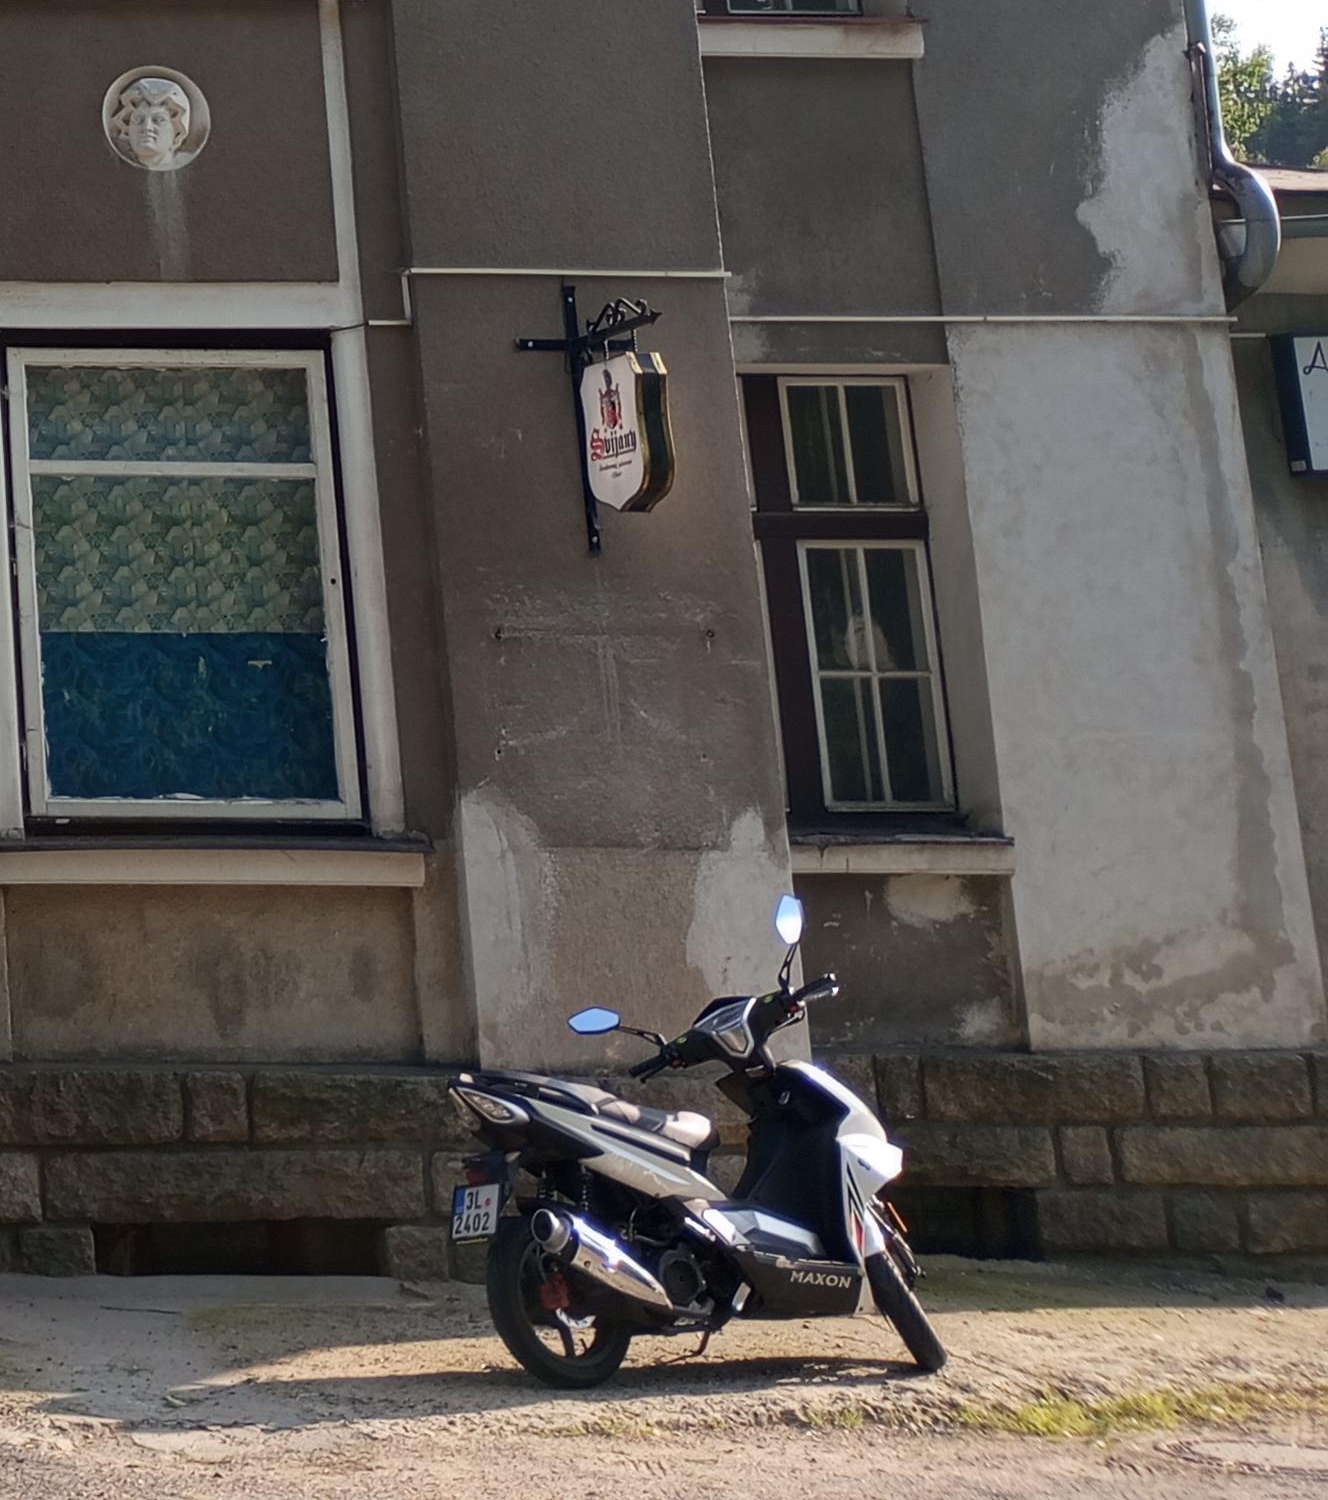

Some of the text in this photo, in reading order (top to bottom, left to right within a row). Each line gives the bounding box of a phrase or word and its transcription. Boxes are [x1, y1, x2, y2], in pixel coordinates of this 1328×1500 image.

[590, 428, 637, 461] Svijany
[466, 1190, 483, 1211] 3L
[454, 1211, 490, 1235] 2402
[790, 1270, 852, 1289] MAXON
